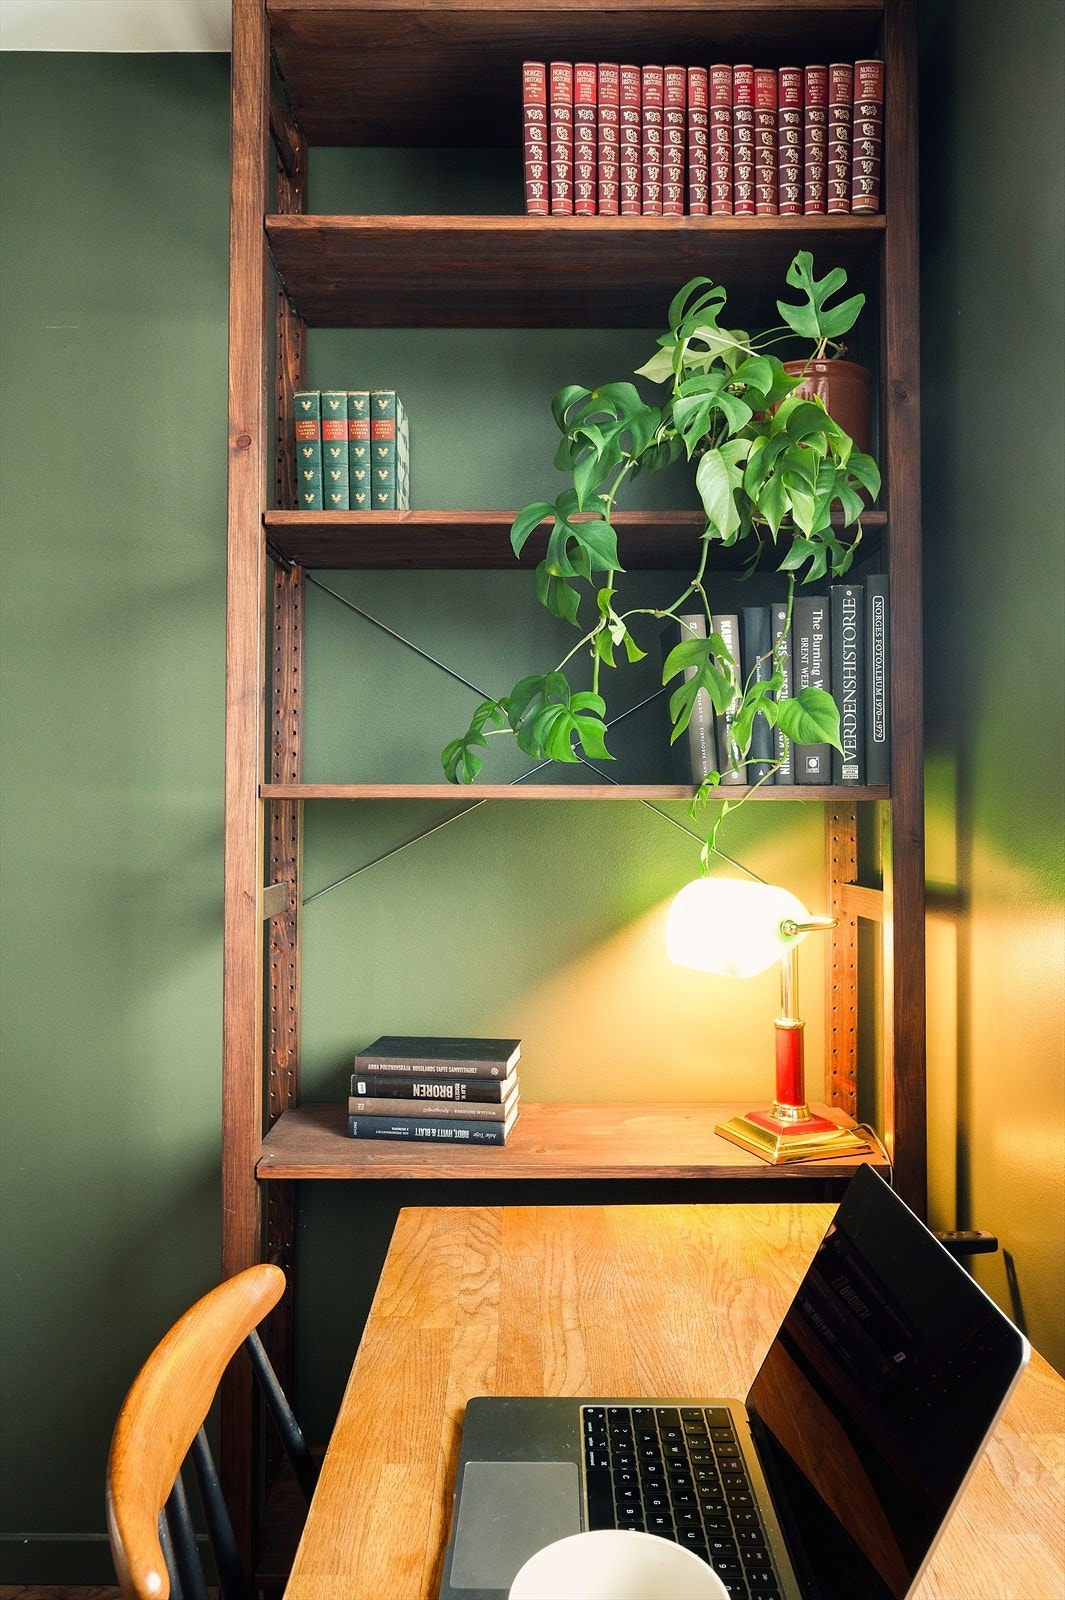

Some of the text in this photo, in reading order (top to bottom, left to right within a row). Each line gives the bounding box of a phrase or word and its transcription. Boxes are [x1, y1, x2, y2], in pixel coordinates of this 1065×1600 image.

[812, 609, 823, 630] The
[874, 601, 882, 637] NORGES
[810, 634, 823, 676] Burning
[842, 598, 857, 763] VERDENSHISTORIE
[413, 1084, 453, 1098] BROREN
[431, 1129, 436, 1137] &
[437, 1129, 452, 1138] HVITT
